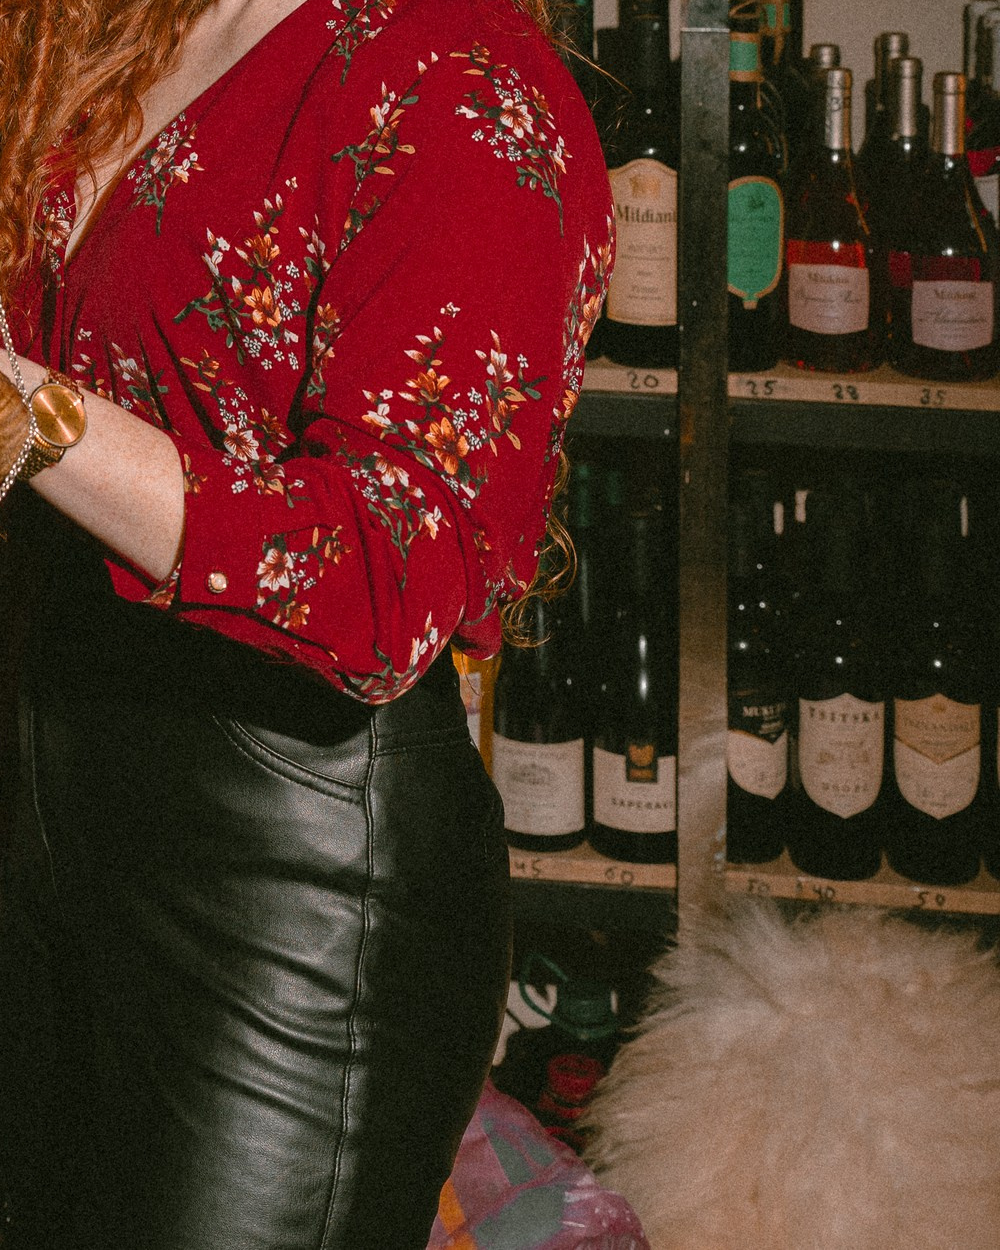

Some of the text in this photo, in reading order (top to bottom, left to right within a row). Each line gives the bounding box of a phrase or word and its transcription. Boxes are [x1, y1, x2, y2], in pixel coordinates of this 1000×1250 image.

[626, 371, 659, 389] 20
[746, 380, 777, 396] 25
[514, 859, 542, 878] 45
[605, 866, 633, 884] 60
[918, 892, 945, 908] 50
